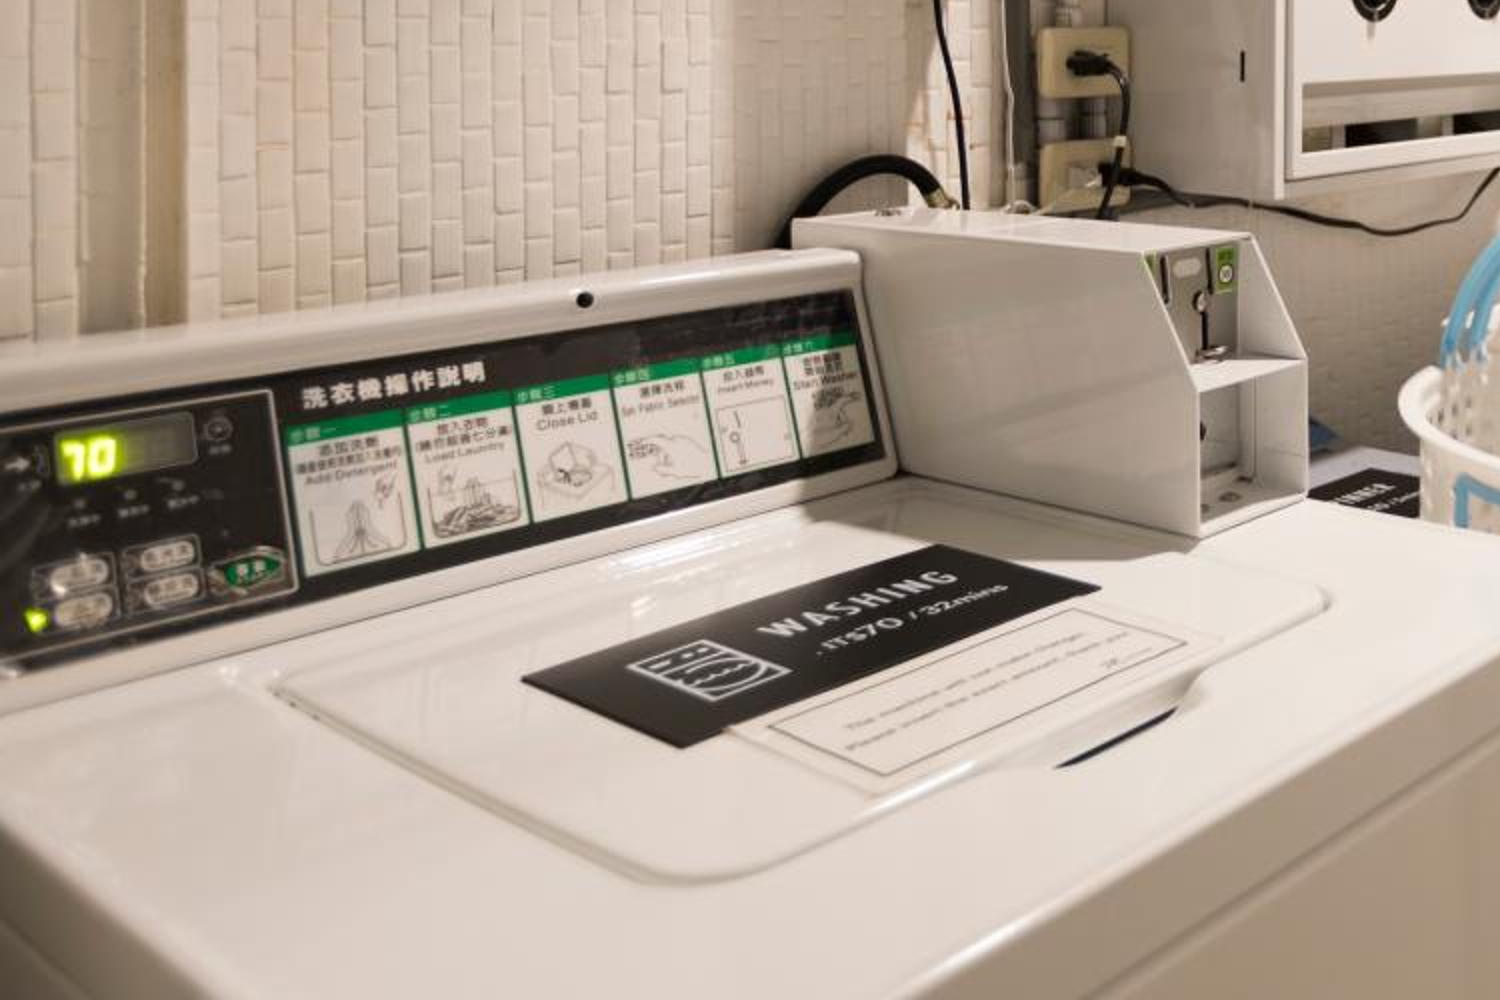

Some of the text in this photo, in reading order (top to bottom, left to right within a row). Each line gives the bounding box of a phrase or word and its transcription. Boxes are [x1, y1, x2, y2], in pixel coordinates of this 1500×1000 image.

[536, 409, 599, 432] Close Lid
[60, 434, 118, 482] 70
[757, 570, 959, 637] WASHING
